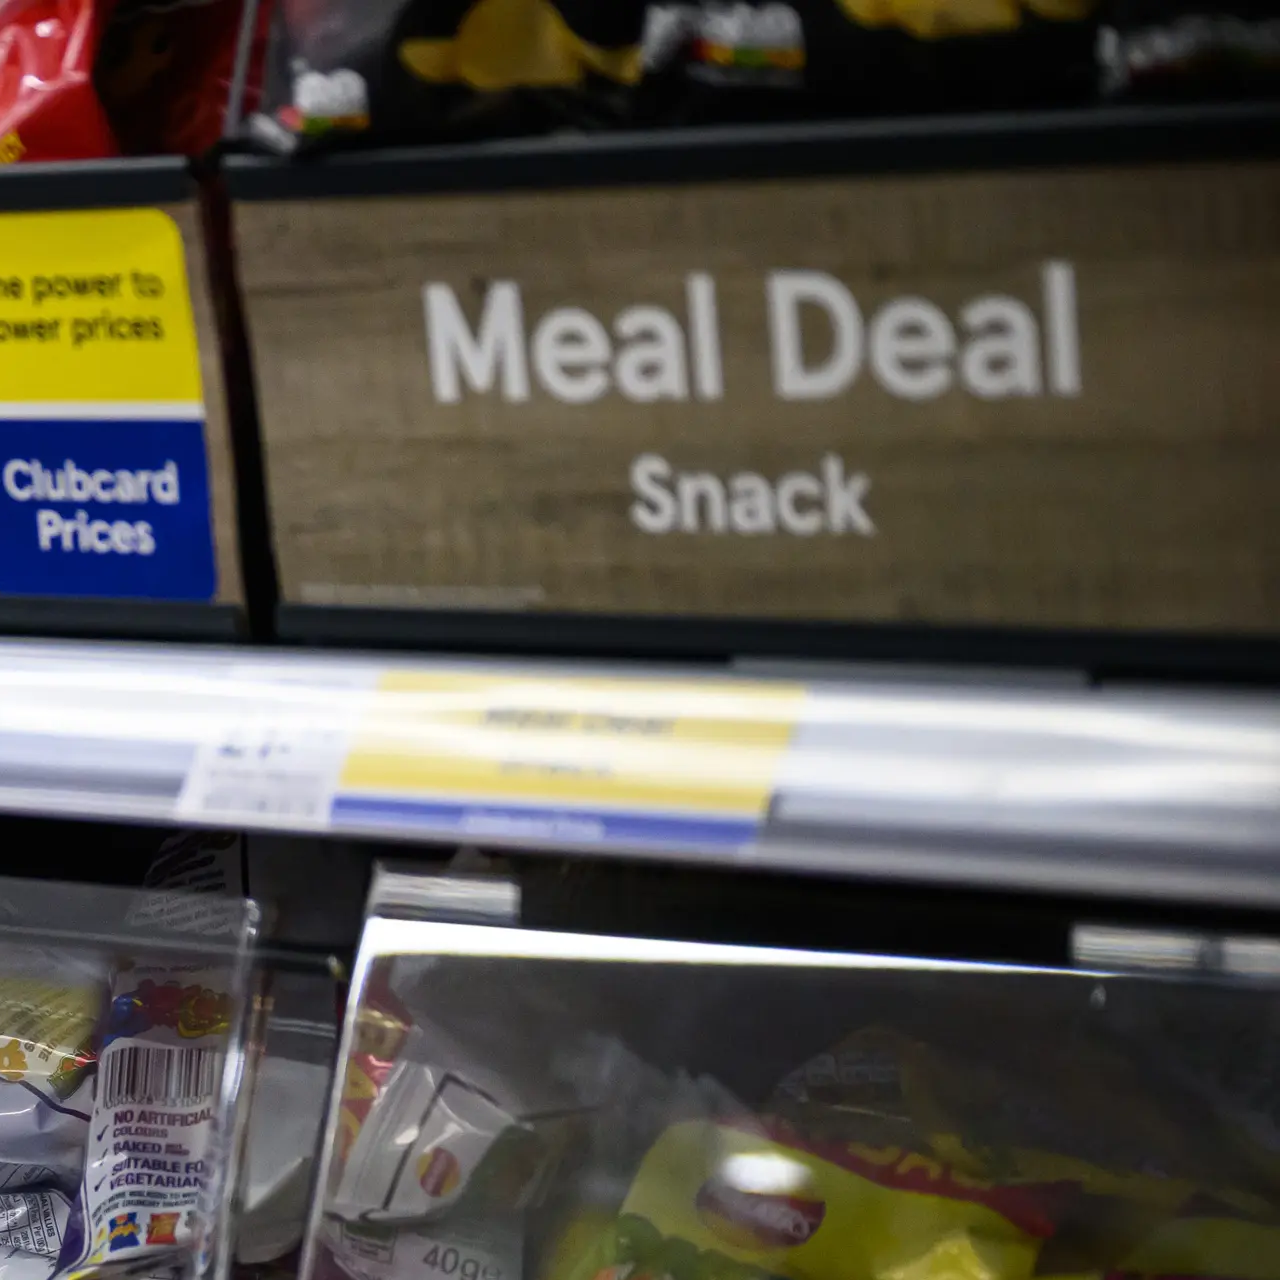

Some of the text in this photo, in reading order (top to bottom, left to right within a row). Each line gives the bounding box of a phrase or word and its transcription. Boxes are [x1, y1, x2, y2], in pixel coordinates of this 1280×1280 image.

[34, 276, 118, 310] power
[129, 270, 164, 301] to
[73, 311, 164, 349] prices
[423, 261, 1082, 403] Meal Deal
[3, 458, 180, 504] Clubcard
[630, 454, 875, 537] Snack
[37, 509, 154, 553] Prices
[113, 1126, 168, 1139] COLOURS
[114, 1107, 212, 1128] NO ARTIFICIAL
[112, 1157, 181, 1176] SUITABLE
[113, 1141, 162, 1155] BAKED
